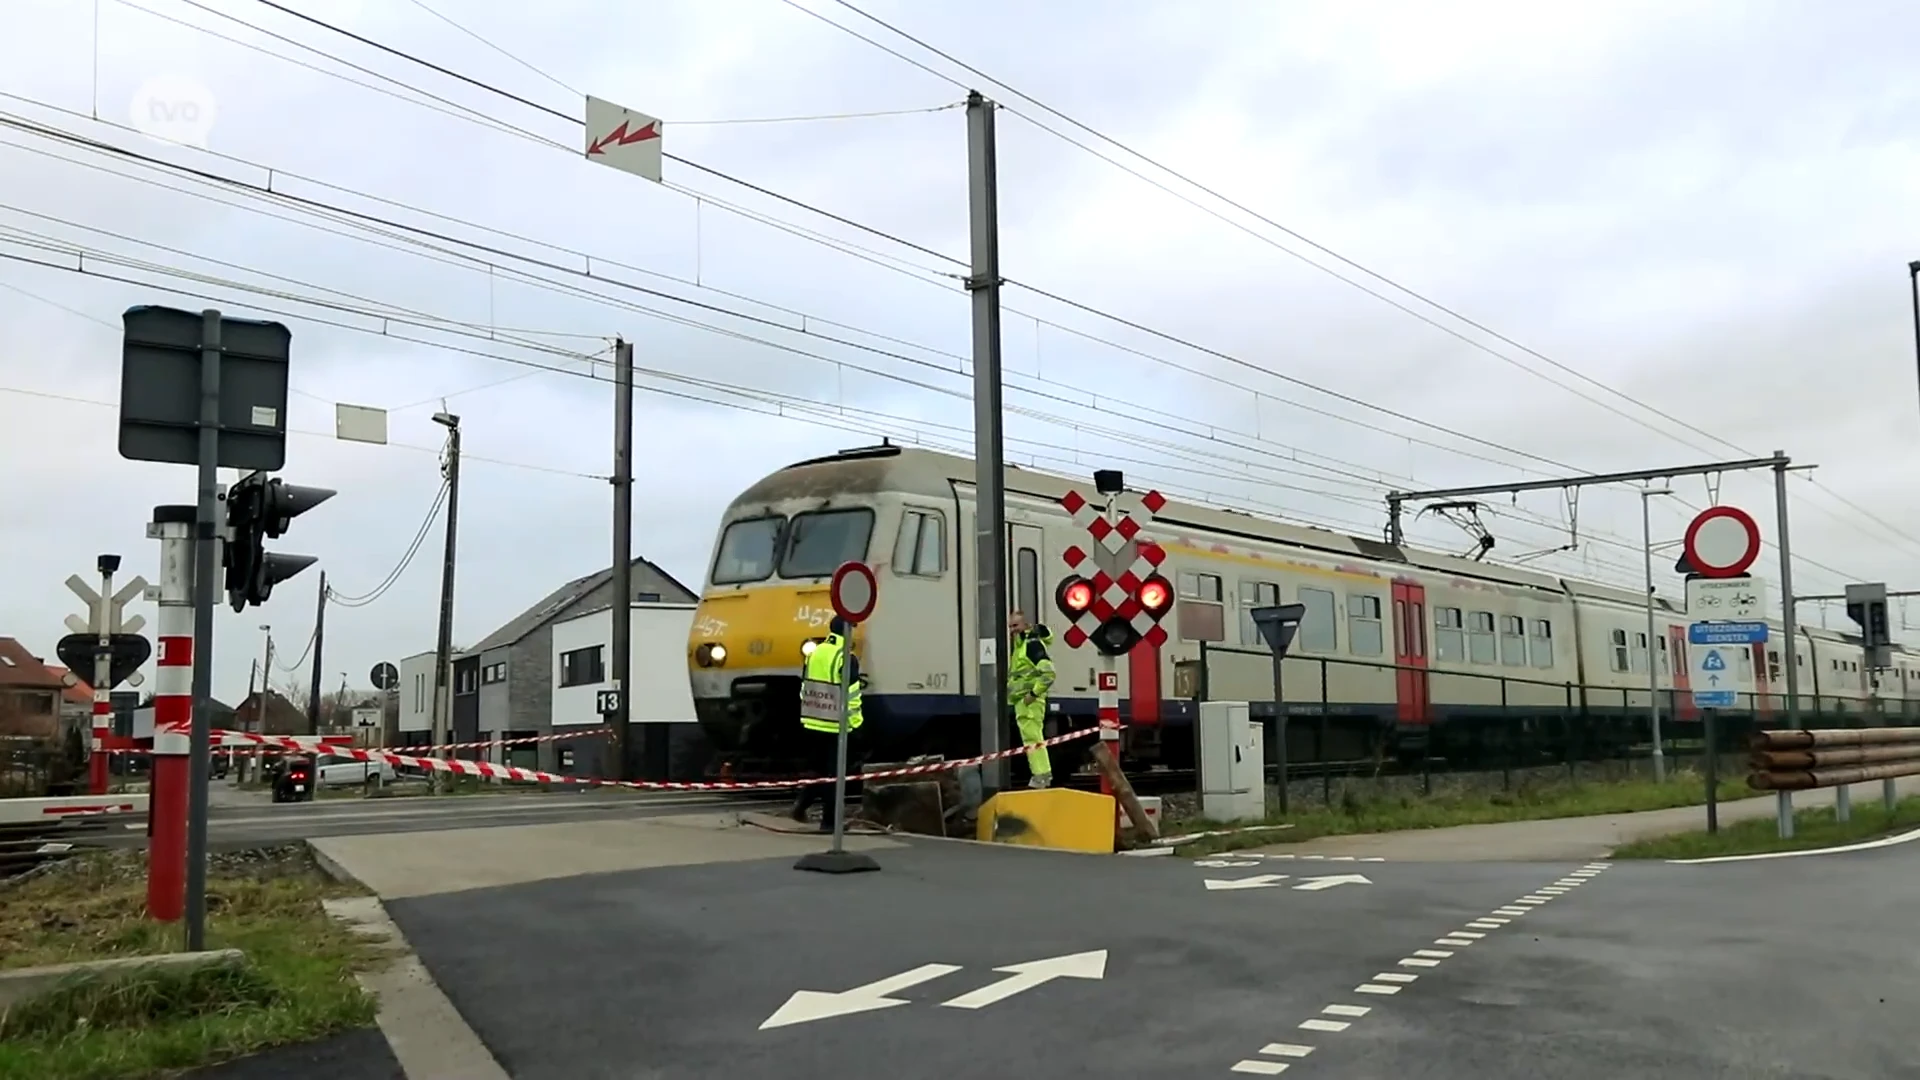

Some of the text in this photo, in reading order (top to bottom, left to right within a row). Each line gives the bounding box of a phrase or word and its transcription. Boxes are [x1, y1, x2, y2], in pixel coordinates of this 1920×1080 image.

[1707, 634, 1750, 642] DIENSTEN
[1707, 657, 1722, 668] F4
[925, 673, 948, 688] 407
[598, 692, 619, 711] 13
